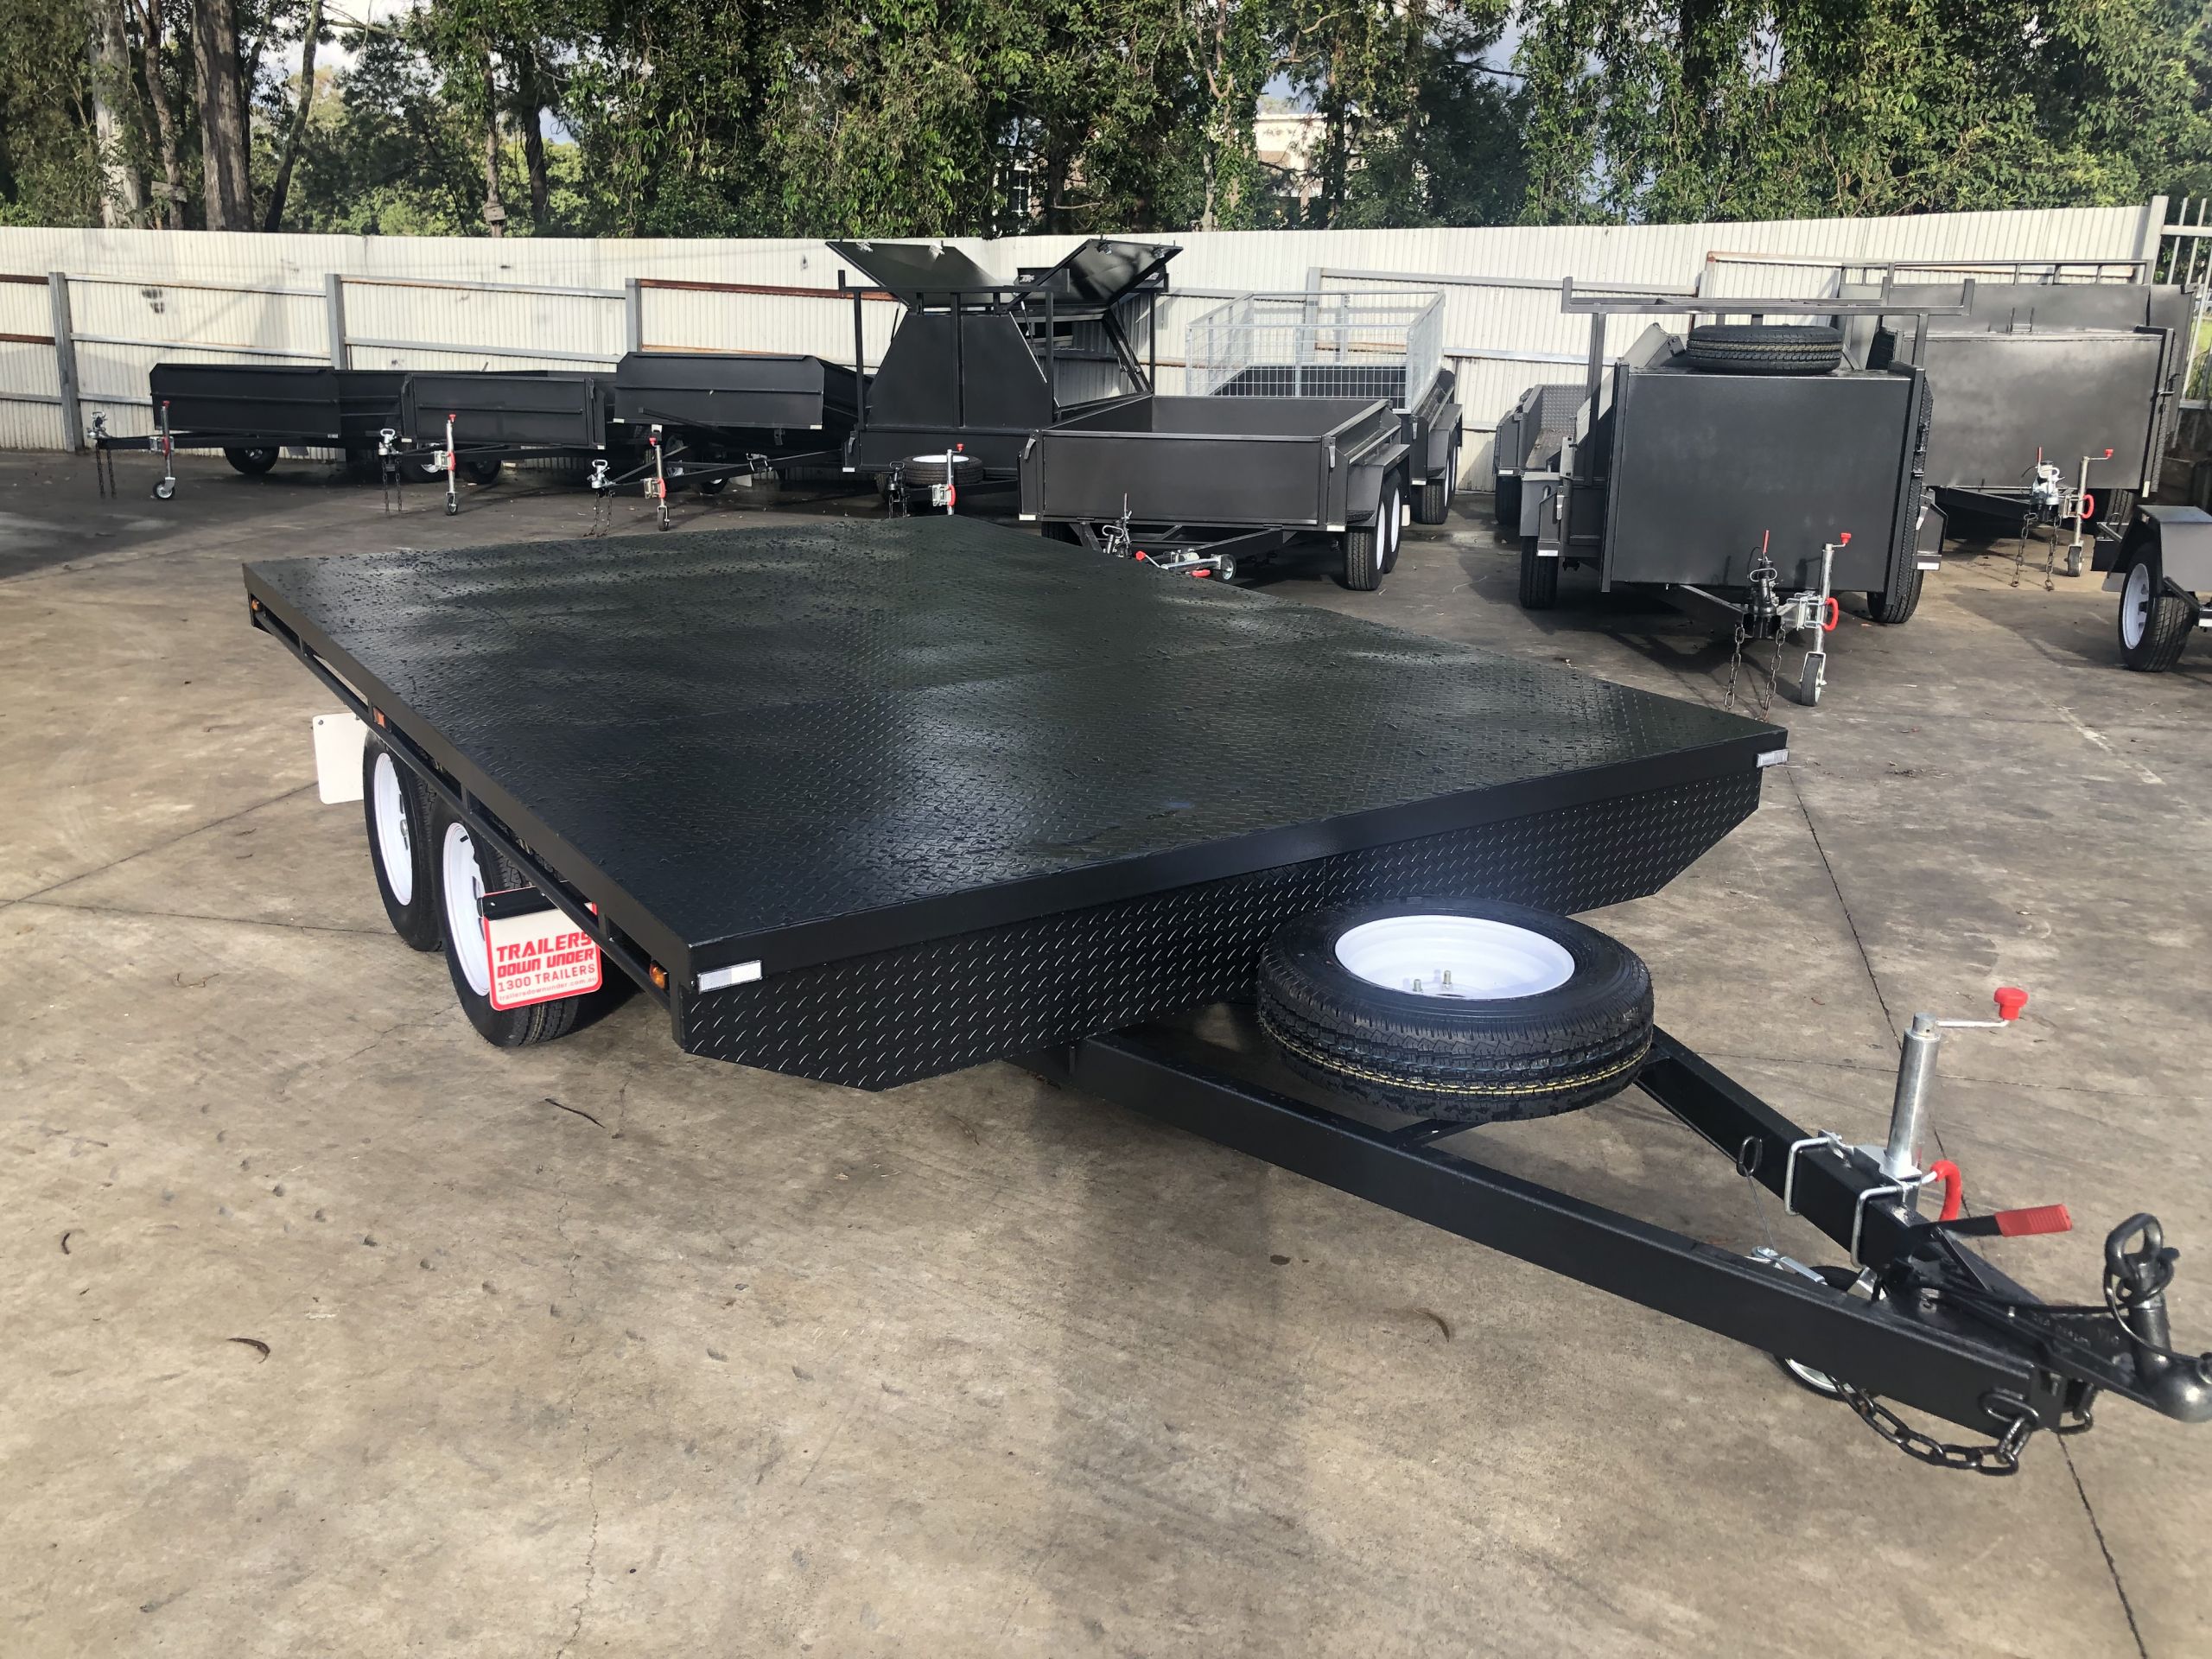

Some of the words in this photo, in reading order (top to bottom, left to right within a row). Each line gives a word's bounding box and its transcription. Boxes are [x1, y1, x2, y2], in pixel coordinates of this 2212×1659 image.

[497, 931, 592, 962] TRAILERS
[498, 958, 541, 978] DOWN
[547, 948, 594, 968] UNDER
[498, 976, 531, 992] 1300
[535, 963, 595, 984] TRAILERS
